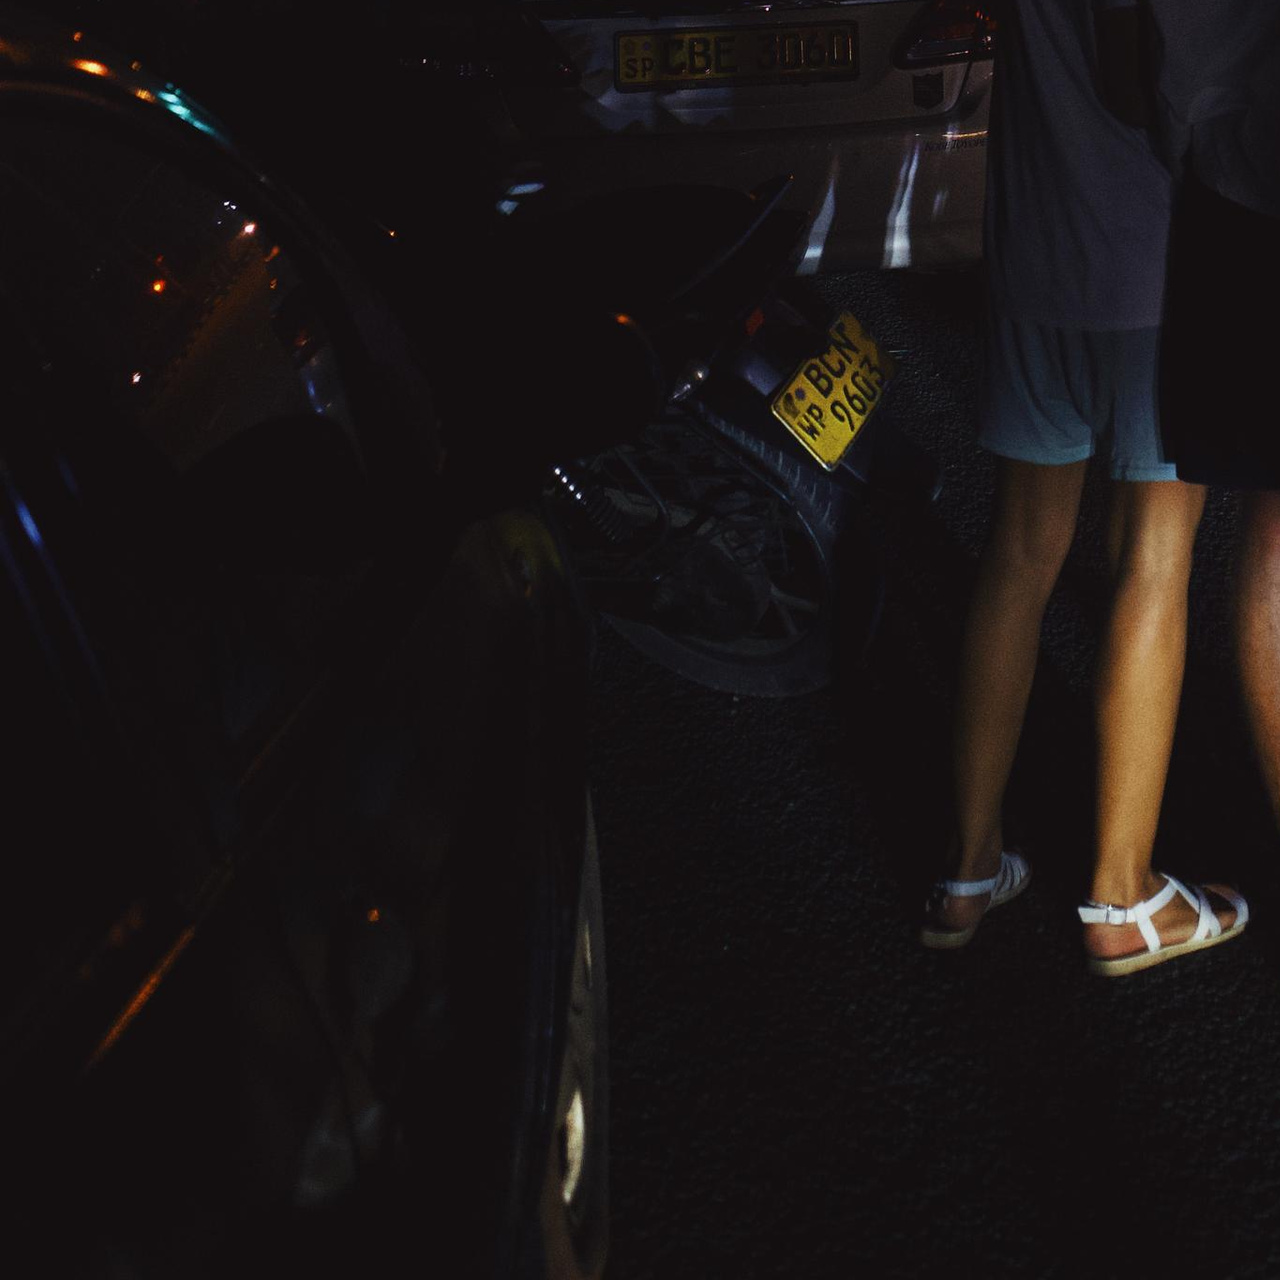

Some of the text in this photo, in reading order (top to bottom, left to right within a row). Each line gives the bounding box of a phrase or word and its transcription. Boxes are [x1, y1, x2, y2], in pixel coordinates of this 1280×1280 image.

[624, 57, 654, 79] SP
[661, 36, 738, 75] CBE
[797, 403, 826, 441] WP
